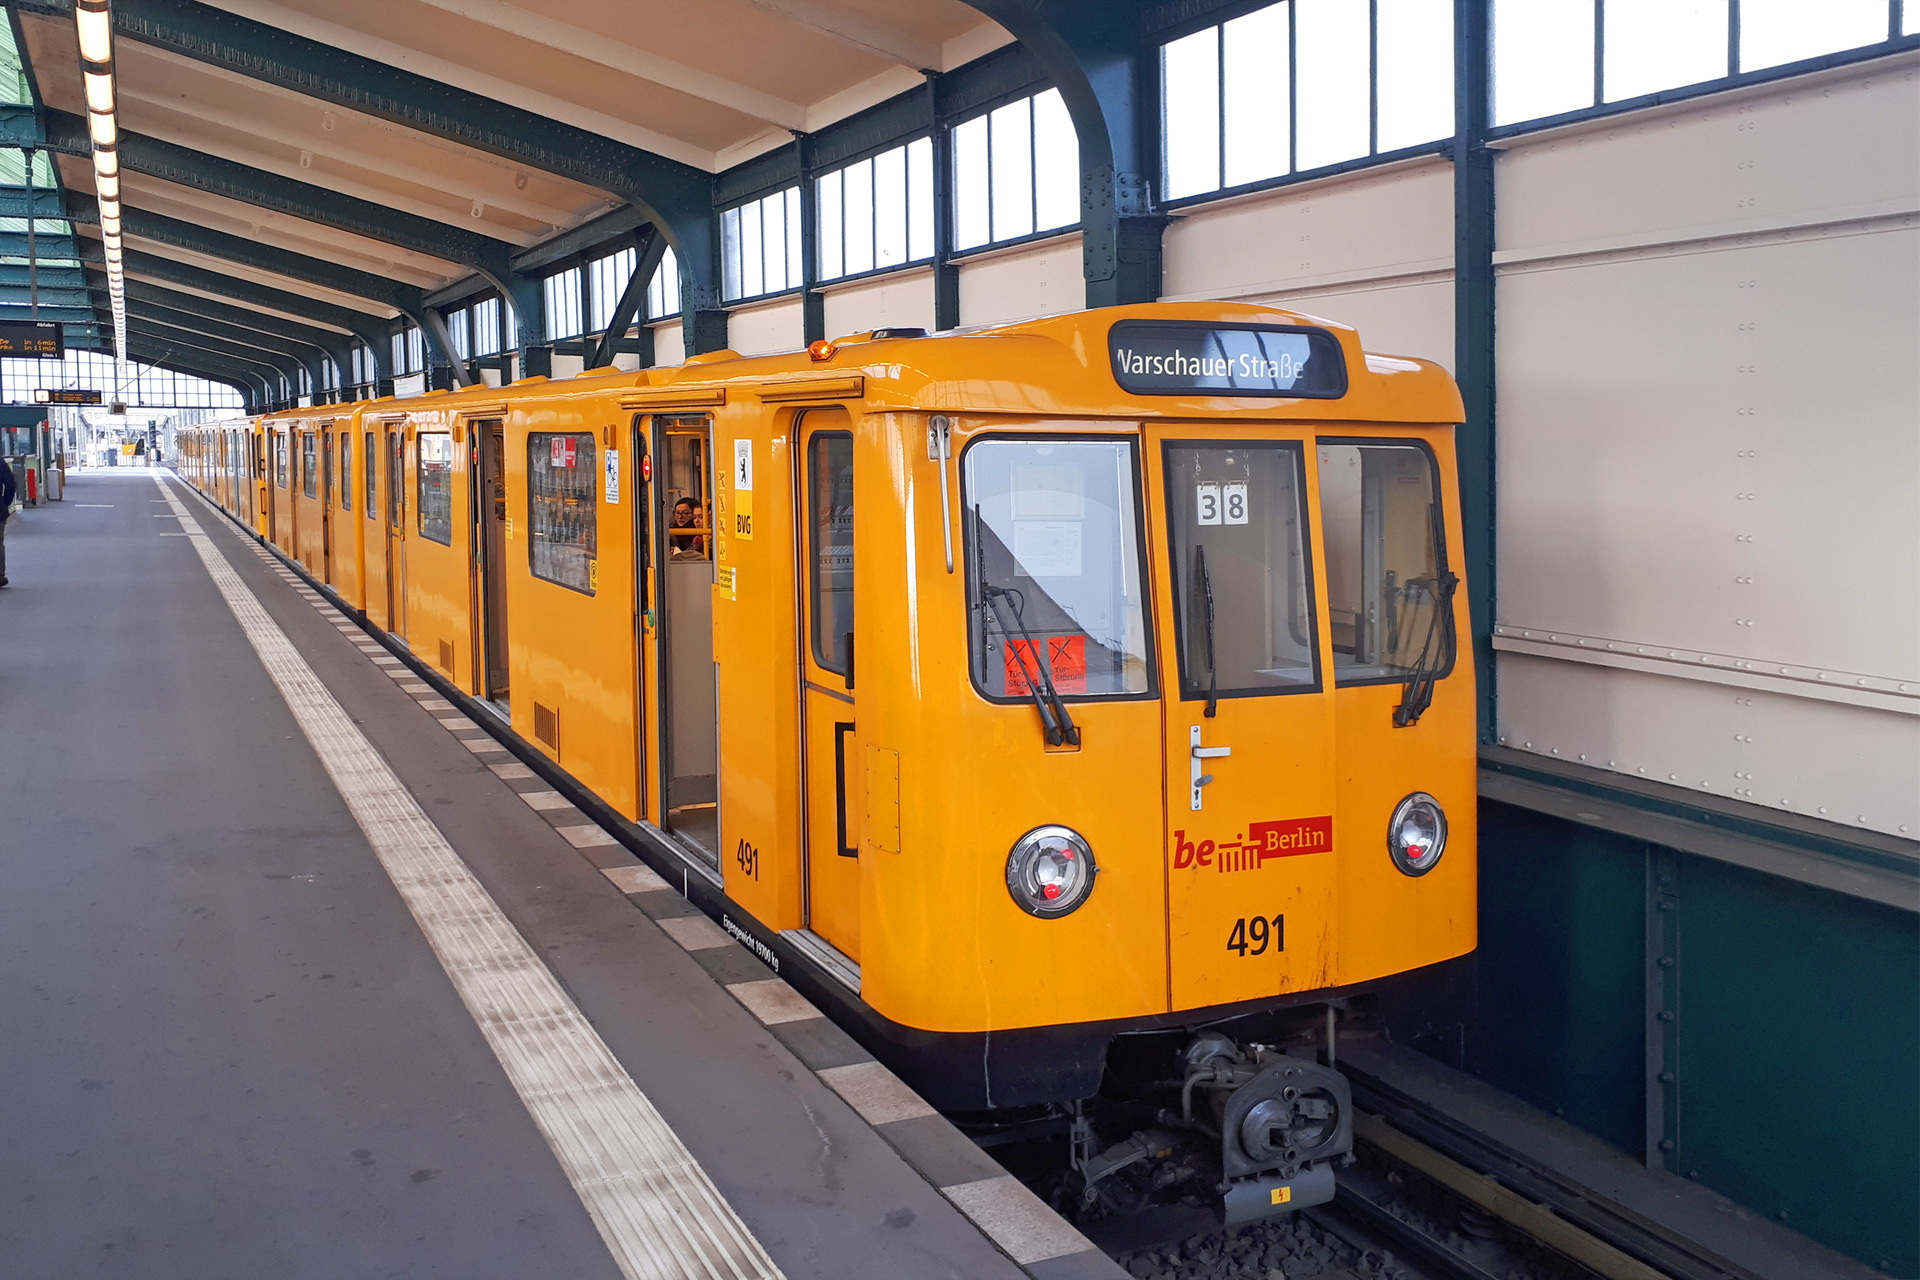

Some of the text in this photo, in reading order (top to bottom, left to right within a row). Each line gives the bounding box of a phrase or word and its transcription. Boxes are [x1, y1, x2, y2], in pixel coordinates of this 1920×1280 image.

[1239, 353, 1304, 379] Straße
[737, 514, 751, 535] BVG
[1265, 827, 1324, 851] Berlin
[737, 838, 758, 881] 491
[723, 913, 779, 972] Eigengewicht 19700 kg
[1227, 914, 1284, 957] 491
